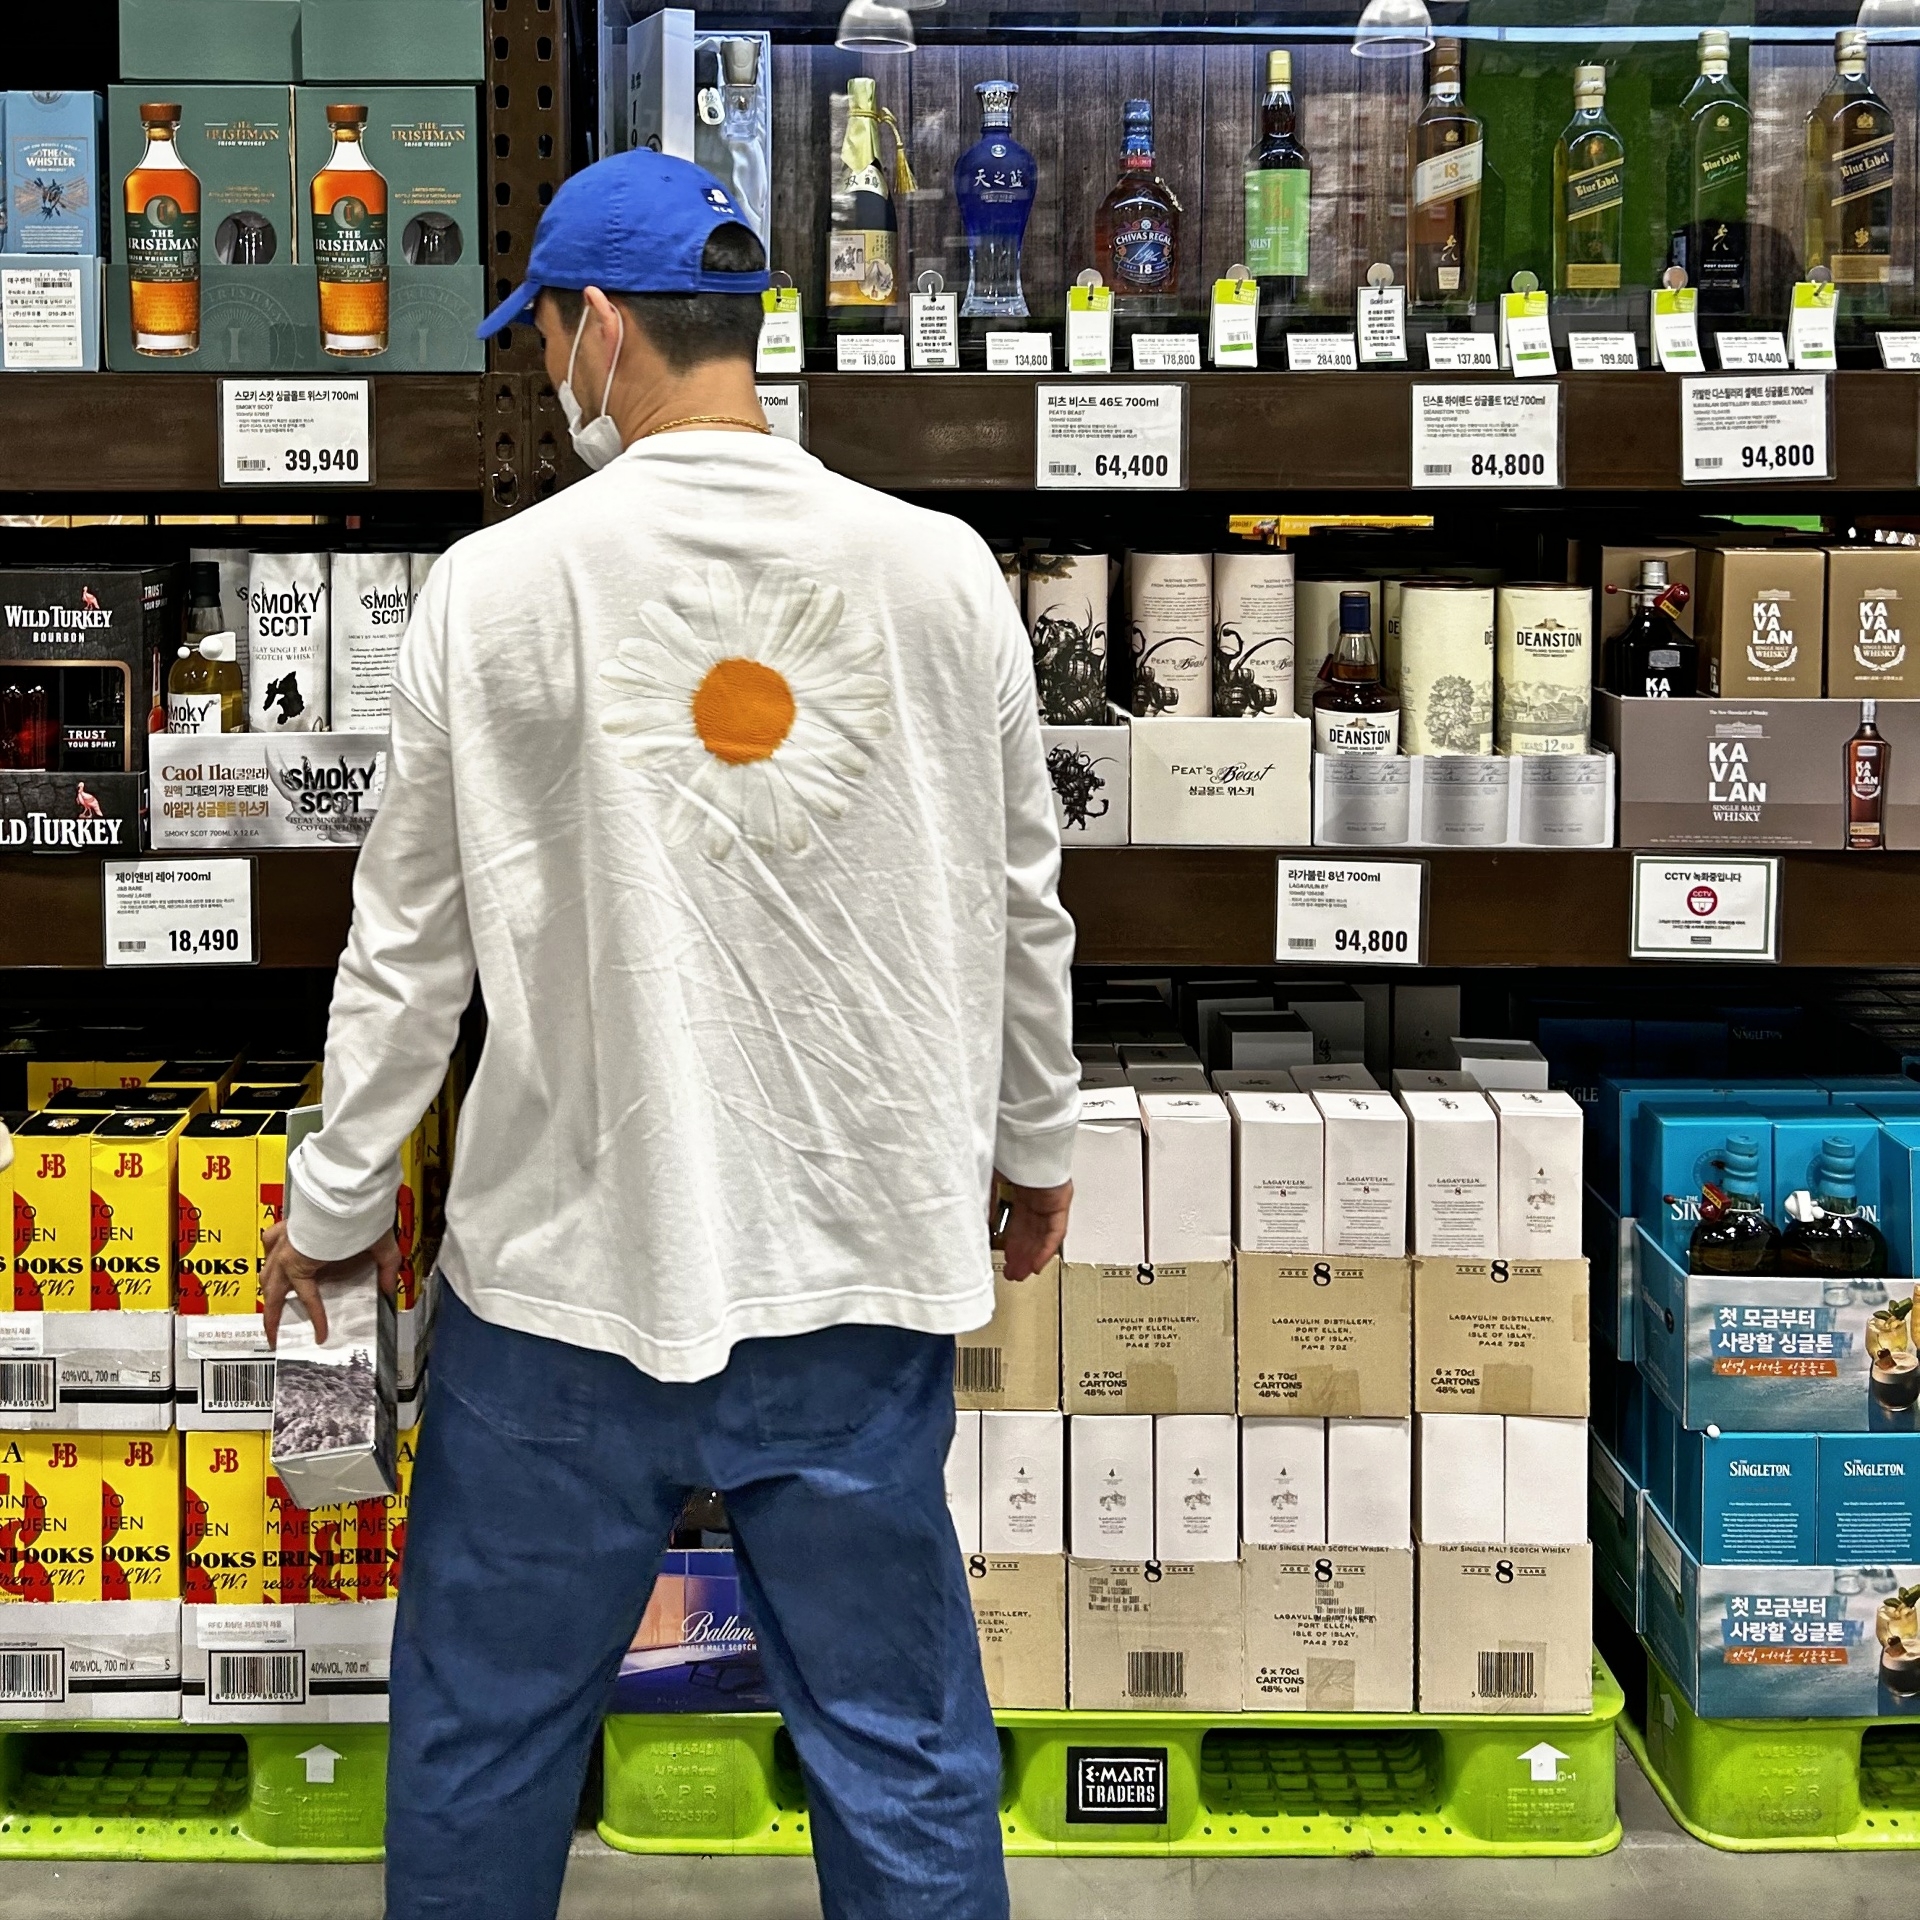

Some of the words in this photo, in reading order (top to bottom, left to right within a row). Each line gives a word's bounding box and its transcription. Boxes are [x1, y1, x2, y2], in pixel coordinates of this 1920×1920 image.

[206, 130, 279, 140] IRISHMAN
[392, 130, 465, 140] IRISHMAN
[26, 157, 76, 167] WHISTLER
[1702, 158, 1721, 172] Blue
[1721, 151, 1741, 165] Label
[1839, 161, 1864, 177] Blue
[1864, 153, 1890, 170] Label
[1444, 163, 1459, 178] 18
[1575, 182, 1596, 197] Blue
[1596, 174, 1619, 189] Label
[128, 237, 199, 250] IRISHMAN
[316, 238, 386, 251] IRISHMAN
[1116, 232, 1147, 244] CHIVAS
[1149, 232, 1171, 246] REGAL
[863, 355, 896, 366] 119,800
[1015, 354, 1048, 366] 134,800
[1162, 354, 1196, 365] 178,800
[1317, 354, 1352, 366] 284,800
[1457, 354, 1492, 365] 137,800
[1748, 352, 1782, 364] 374,400
[234, 390, 257, 402] 스모키
[258, 390, 274, 402] 스캇
[276, 390, 306, 402] 싱글몰트
[308, 390, 330, 402] 위스키
[332, 390, 359, 400] 700ml
[764, 396, 788, 406] 700ml
[1692, 388, 1712, 400] 카발란
[1764, 386, 1790, 398] 싱글몰트
[1790, 386, 1814, 396] 700ml
[1048, 396, 1067, 408] 피츠
[1068, 396, 1098, 408] 비스트
[1099, 396, 1123, 407] 46도
[1125, 397, 1159, 407] 700ml
[285, 448, 359, 474] 39,940
[1742, 444, 1814, 470] 94,800
[1095, 454, 1168, 480] 64,400
[1471, 454, 1544, 478] 84,800
[144, 584, 164, 598] TRUST
[251, 580, 327, 615] SMOKY
[360, 585, 410, 610] SMOKY
[1753, 602, 1780, 617] KA
[1860, 602, 1888, 616] KA
[4, 605, 50, 628] WILD
[50, 606, 113, 630] TURKEY
[1754, 617, 1780, 630] VA
[1860, 616, 1887, 630] VA
[258, 616, 312, 637] SCOT
[32, 632, 85, 643] BOURBON
[1516, 631, 1582, 648] DEANSTON
[1752, 630, 1793, 644] LAN
[1860, 630, 1900, 644] LAN
[1755, 650, 1788, 658] WHISKY
[1863, 650, 1896, 658] WHISKY
[1174, 655, 1208, 671] Beast
[1646, 678, 1671, 692] KA
[168, 698, 217, 722] MOKY
[1329, 728, 1390, 746] DEANSTON
[1708, 742, 1748, 762] KA
[162, 764, 203, 781] Caol
[280, 754, 376, 792] SMOKY
[1710, 762, 1748, 782] VA
[1856, 761, 1871, 770] KA
[1856, 769, 1871, 778] VA
[1856, 776, 1878, 785] LAN
[164, 784, 183, 798] 원액
[186, 784, 216, 798] 그대로의
[218, 784, 236, 797] 가장
[236, 784, 268, 797] 트렌디한
[1228, 786, 1255, 796] 위스키
[1708, 782, 1766, 802] LAN
[164, 802, 194, 818] 아일라
[196, 802, 237, 817] 싱글몰트
[239, 802, 269, 817] 위스키
[0, 818, 28, 845] LD
[27, 812, 122, 848] TURKEY
[115, 872, 153, 884] 제이앤비
[156, 871, 175, 883] 레어
[176, 872, 212, 882] 700ml
[1288, 869, 1326, 882] 라가불린
[1328, 870, 1345, 882] 8년
[1346, 872, 1380, 882] 700ml
[1664, 872, 1692, 881] CCTV
[1693, 872, 1742, 882] 녹화중입니다
[168, 928, 238, 954] 18,490
[1334, 929, 1408, 954] 94,800
[36, 1154, 66, 1179] J&B
[114, 1152, 144, 1178] J&B
[201, 1155, 232, 1180] J&B
[14, 1257, 84, 1274] OOKS
[178, 1258, 249, 1276] OOKS
[1136, 1262, 1154, 1286] 8
[1718, 1308, 1737, 1328] 첫
[1742, 1308, 1816, 1330] 모금부터
[1718, 1333, 1775, 1354] 사랑할
[1778, 1334, 1834, 1354] 싱글톤
[1078, 1380, 1128, 1388] CARTONS
[1084, 1388, 1106, 1396] 48%
[1108, 1388, 1122, 1396] vol
[48, 1442, 78, 1468] J&B
[124, 1442, 154, 1467] J&B
[209, 1448, 239, 1474] J&B
[1730, 1461, 1792, 1477] SINGLETON
[1844, 1460, 1906, 1476] SINGLETON
[1730, 1597, 1750, 1618] 첫
[1754, 1596, 1827, 1618] 모금부터
[679, 1610, 755, 1644] Ballan
[1730, 1620, 1786, 1642] 사랑할
[1790, 1621, 1844, 1642] 싱글톤
[69, 1660, 102, 1672] 40%VOL,
[104, 1661, 117, 1672] 700
[119, 1660, 128, 1670] ml
[129, 1662, 134, 1670] x
[1086, 1785, 1155, 1803] TRADERS
